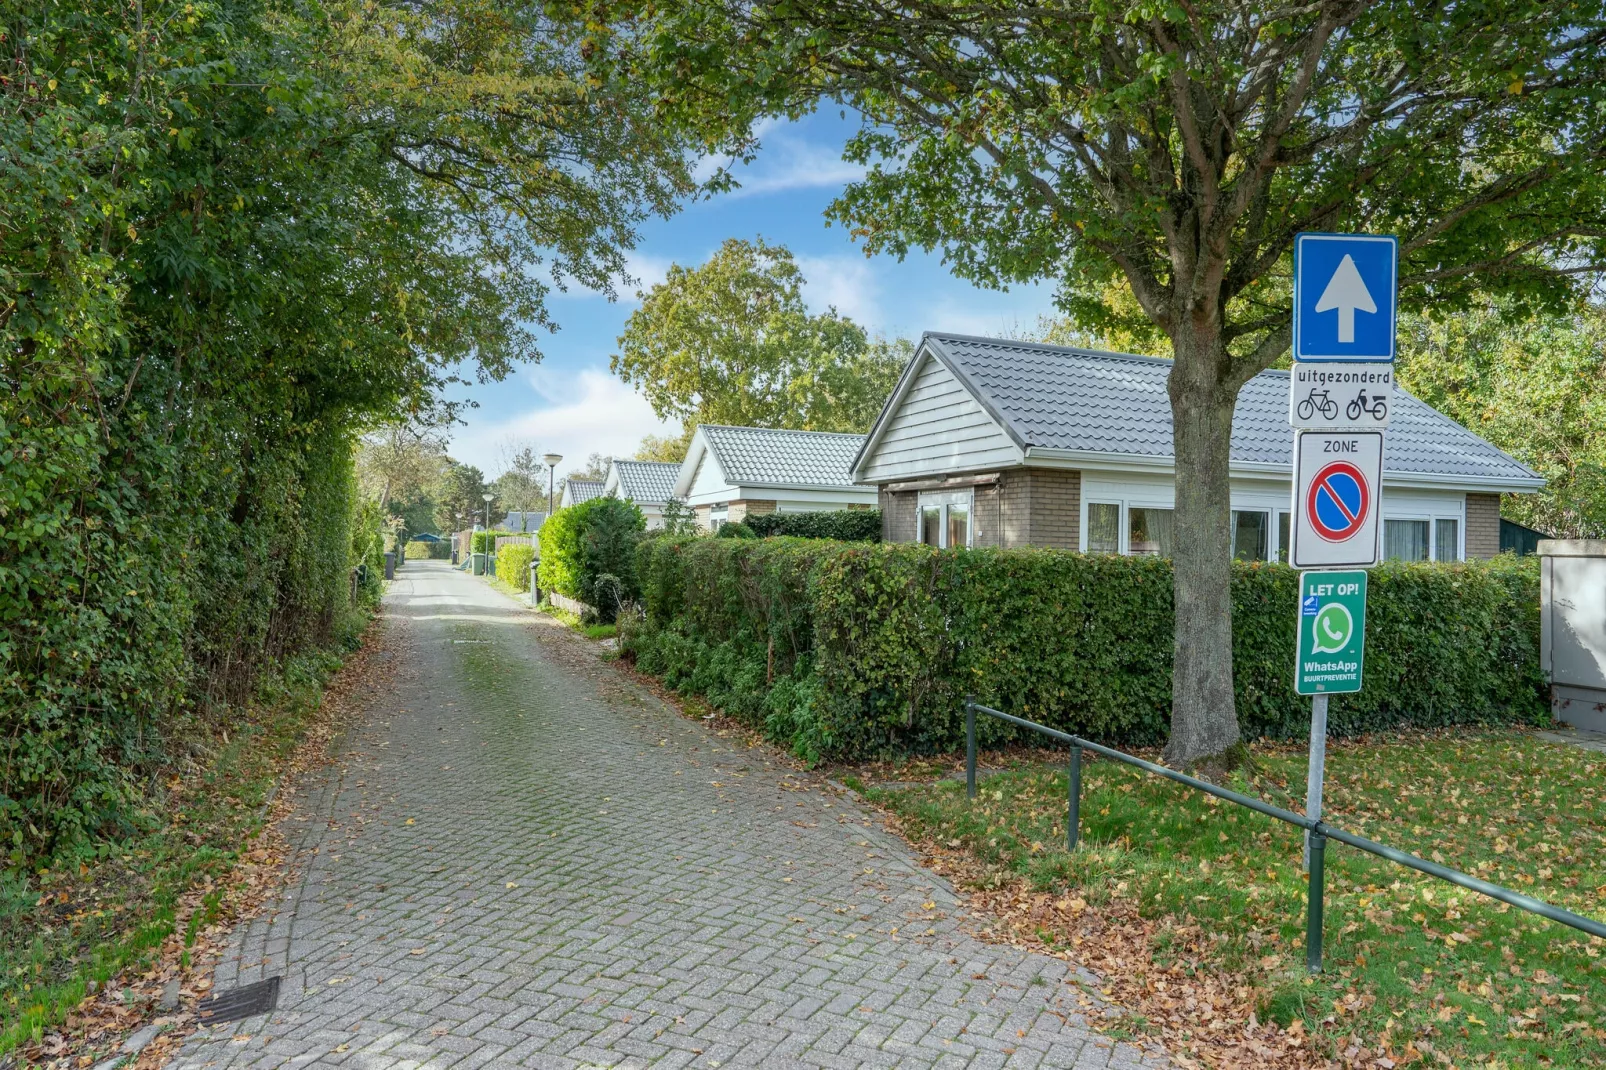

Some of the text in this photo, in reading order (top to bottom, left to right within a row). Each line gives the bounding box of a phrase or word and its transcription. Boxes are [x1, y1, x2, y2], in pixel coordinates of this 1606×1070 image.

[1298, 370, 1390, 386] uitgezonderd
[1323, 440, 1359, 453] ZONE
[1309, 583, 1359, 596] LET OP!
[1304, 661, 1358, 672] WhatsApp
[1303, 673, 1357, 683] BUURTPREVENTIE
